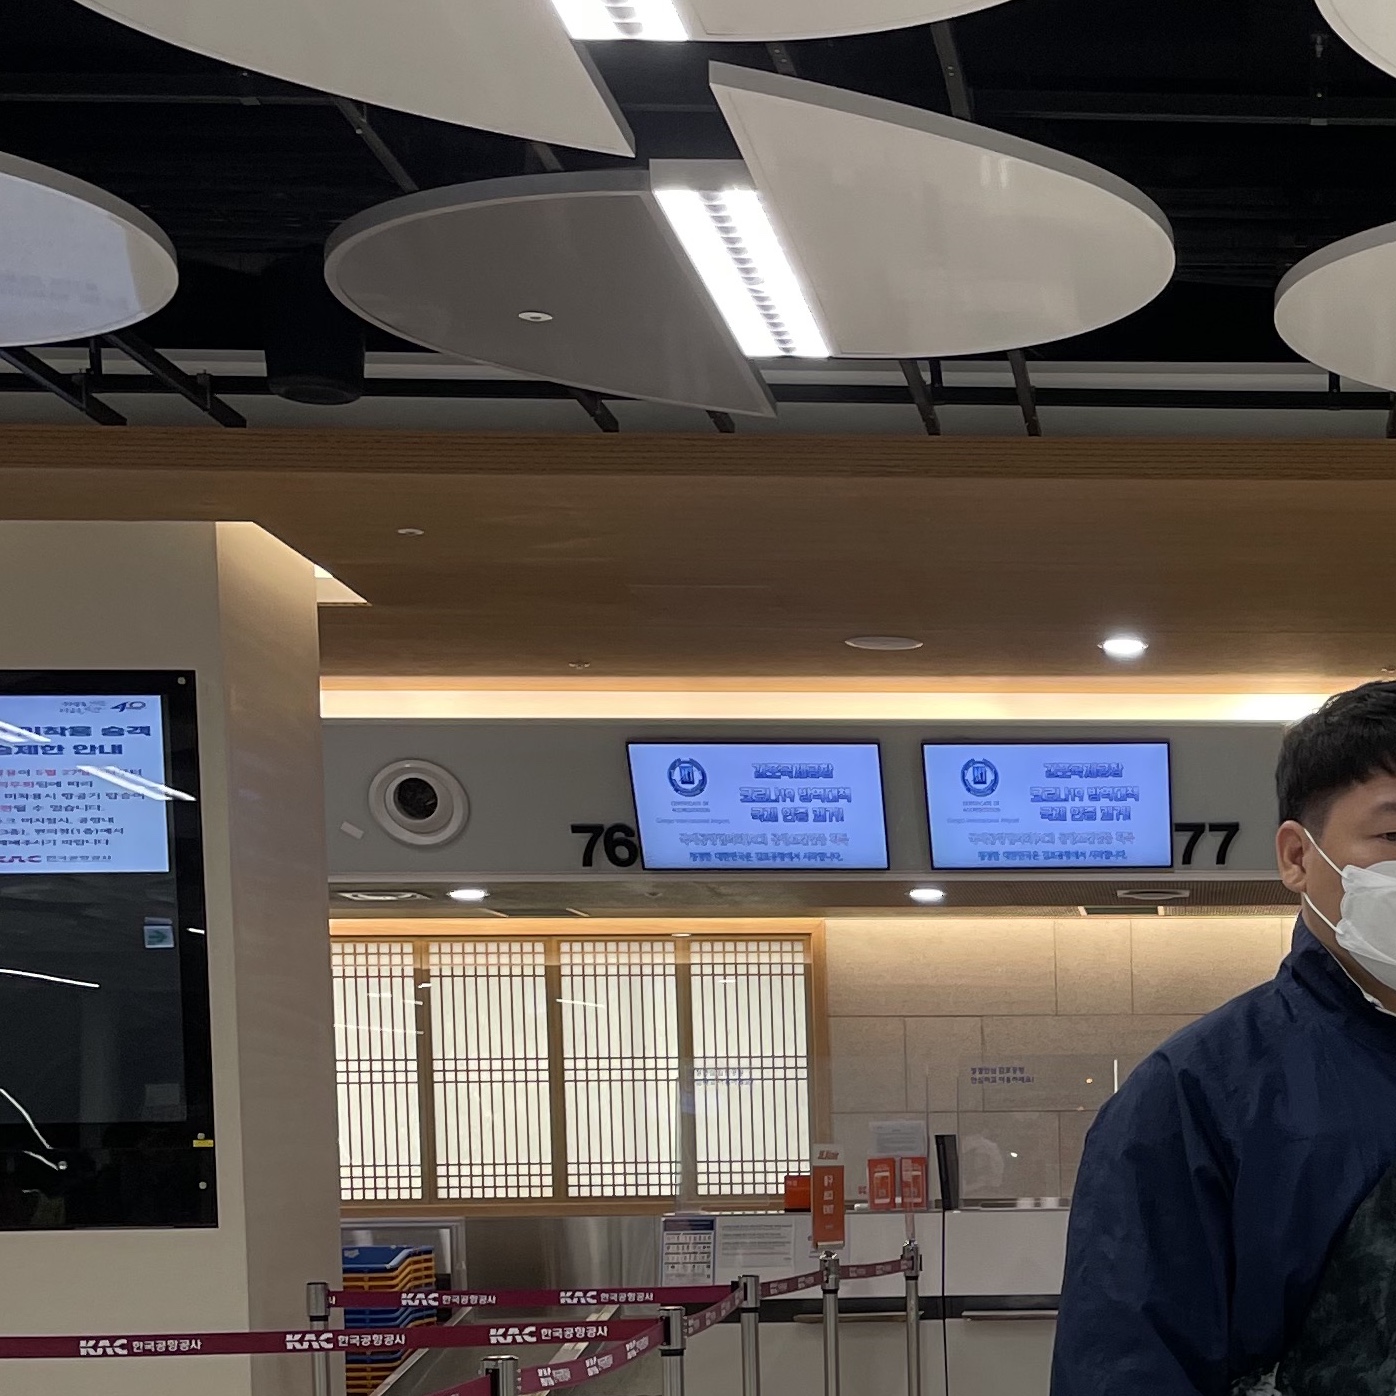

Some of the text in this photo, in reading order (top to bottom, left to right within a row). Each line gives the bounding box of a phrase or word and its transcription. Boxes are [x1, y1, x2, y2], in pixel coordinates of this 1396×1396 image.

[72, 744, 123, 755] 안내
[571, 823, 639, 868] 76
[1174, 822, 1241, 866] 77
[401, 1292, 497, 1306] KAC 한국공항공사
[559, 1291, 654, 1304] KAC 한국공항공사
[285, 1332, 406, 1350] KAC 한국공항공사
[488, 1325, 608, 1344] KAC 한국공항공사
[79, 1338, 203, 1356] KAC 한국공항공사
